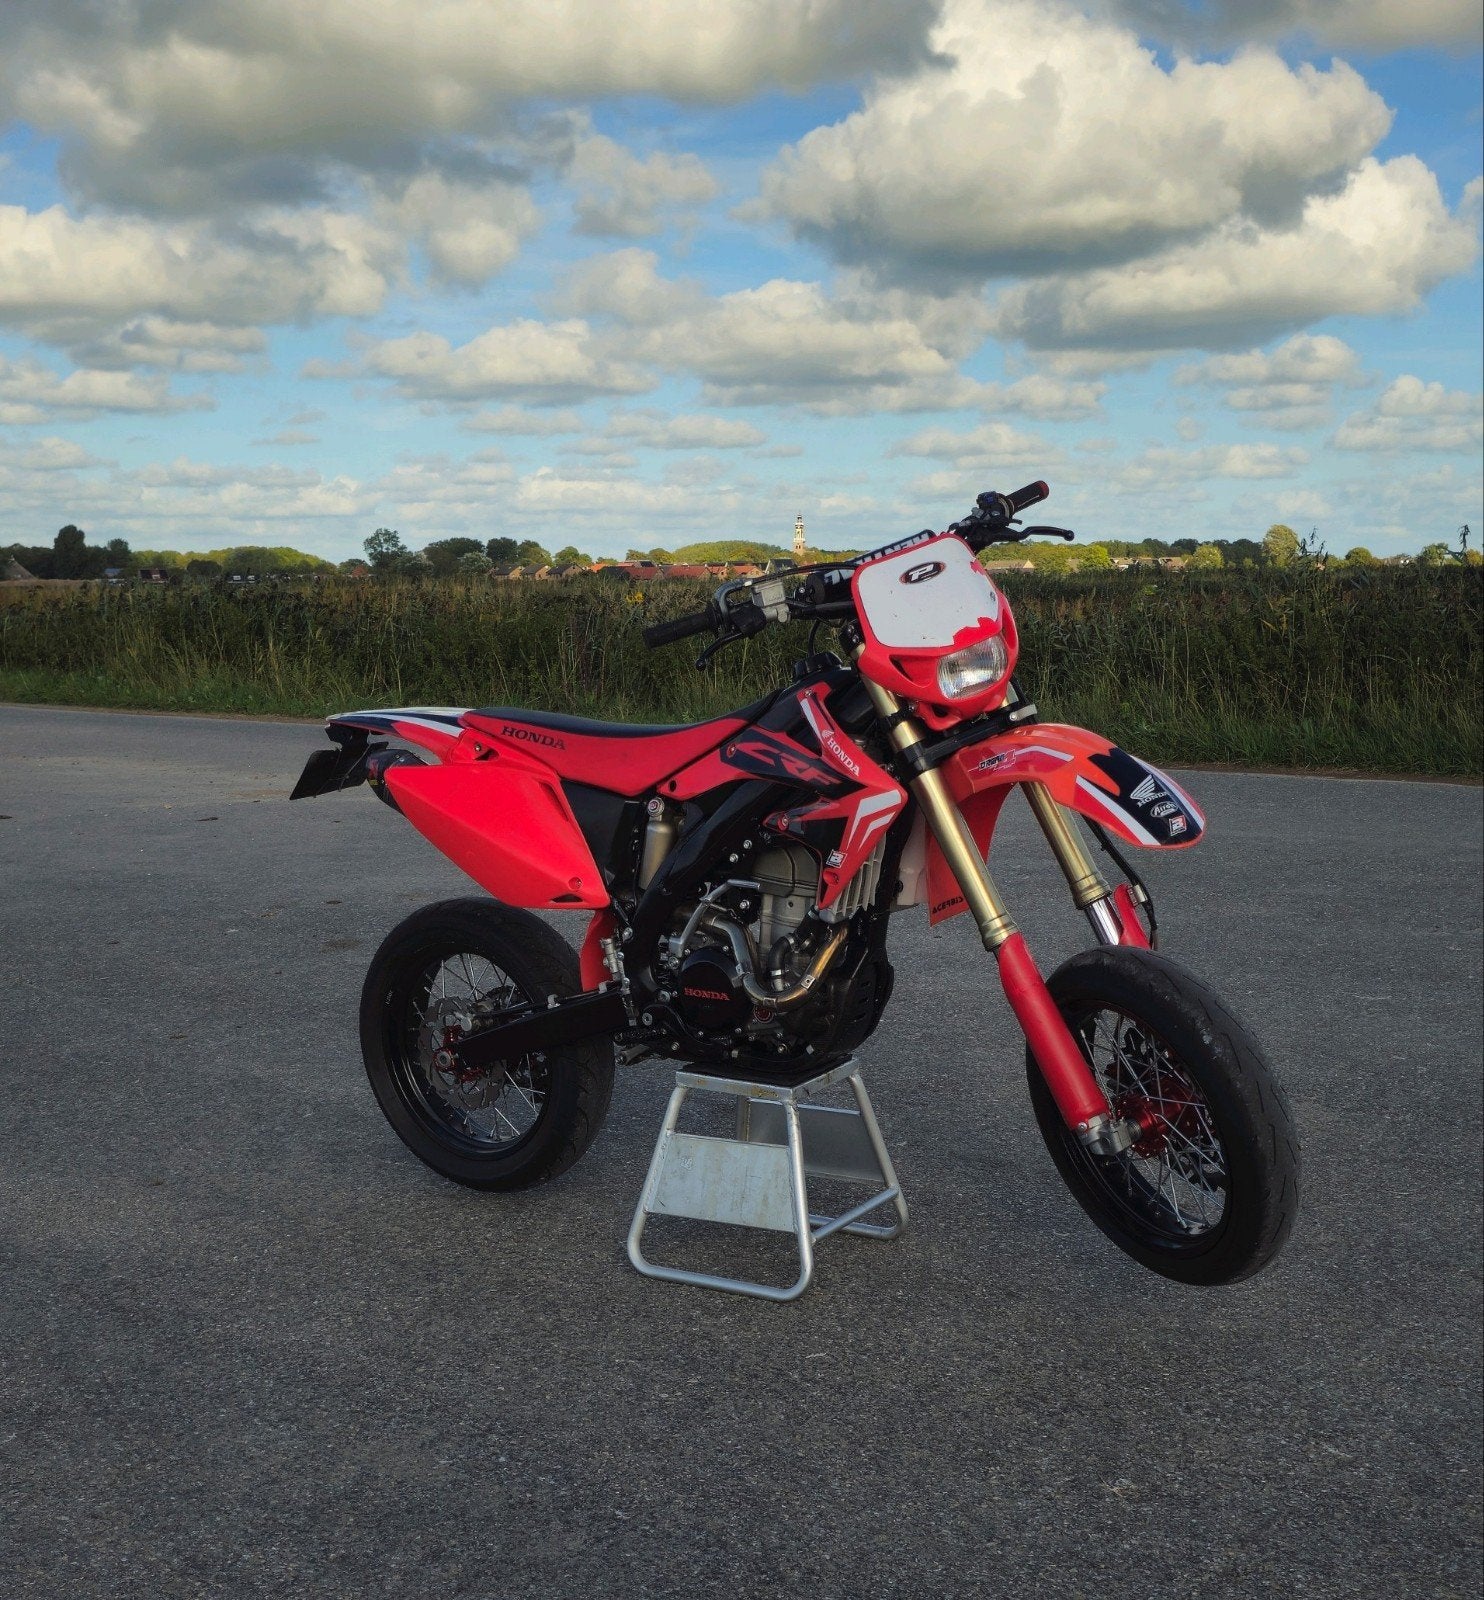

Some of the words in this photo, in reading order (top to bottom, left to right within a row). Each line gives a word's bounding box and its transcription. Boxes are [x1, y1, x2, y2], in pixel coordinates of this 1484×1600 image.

[501, 725, 566, 751] HONDA
[735, 741, 843, 786] CRF
[826, 737, 860, 777] HONDA
[1136, 791, 1170, 808] HONDA
[684, 986, 730, 1001] HONDA
